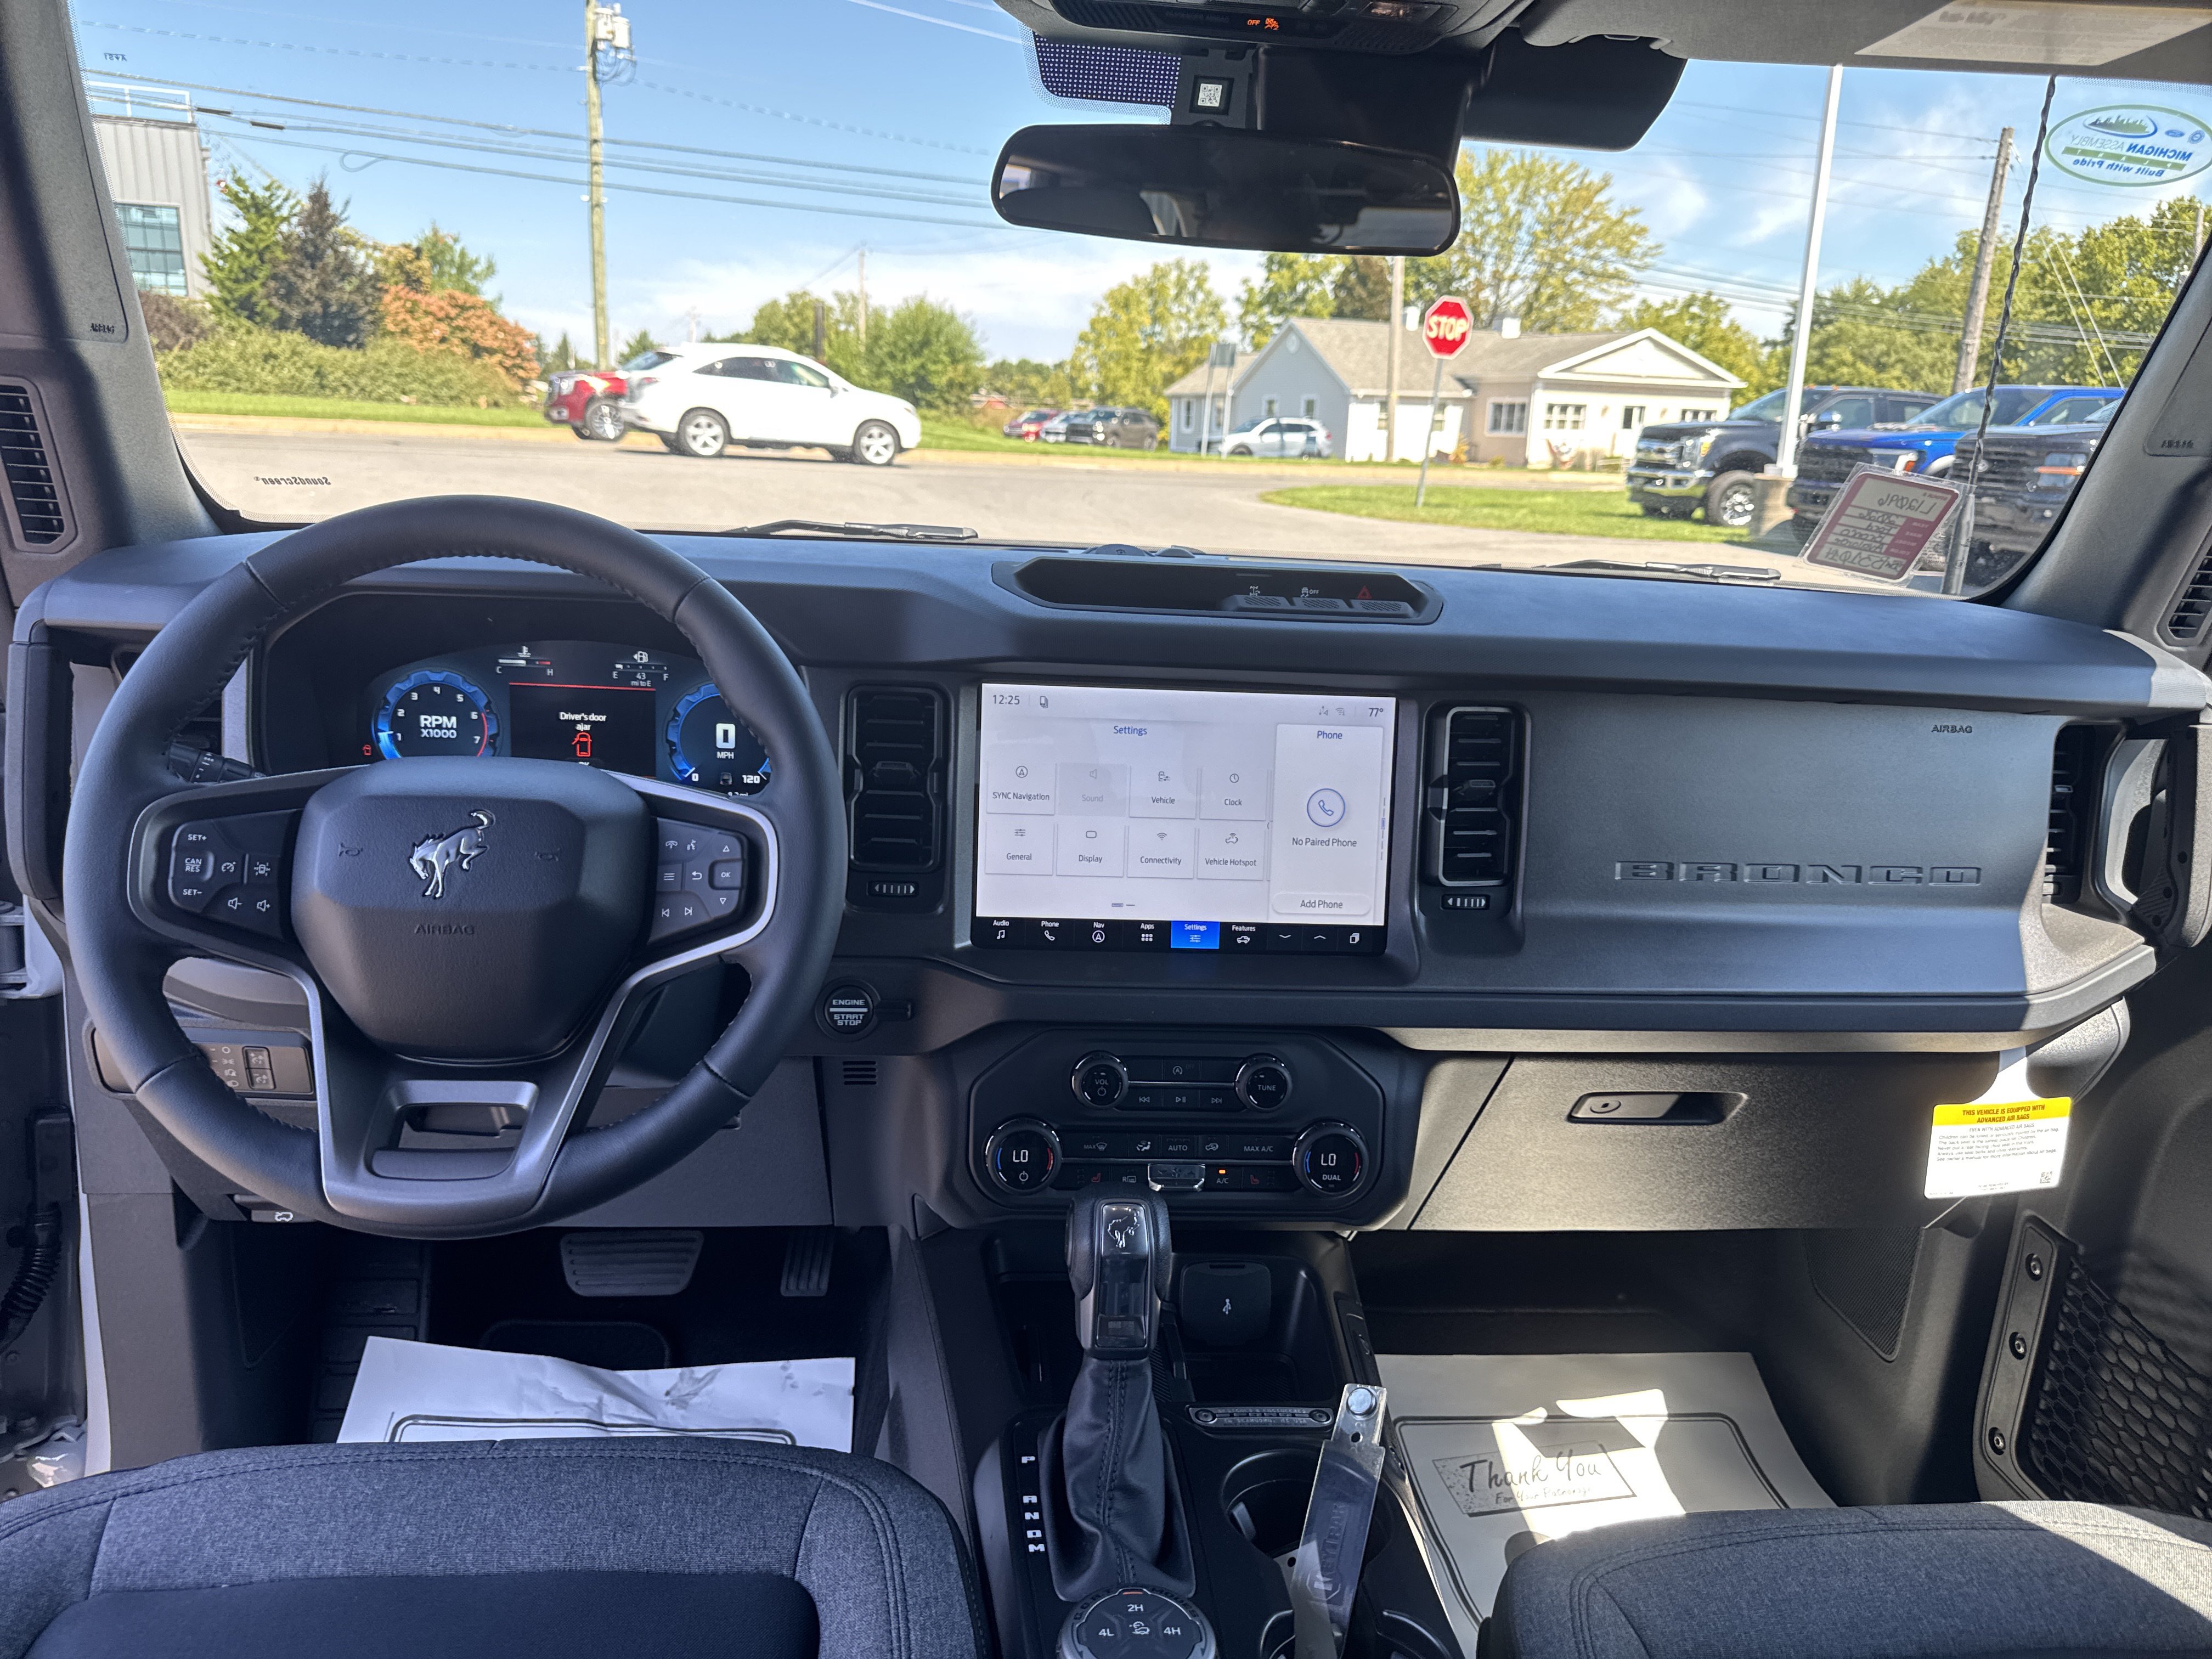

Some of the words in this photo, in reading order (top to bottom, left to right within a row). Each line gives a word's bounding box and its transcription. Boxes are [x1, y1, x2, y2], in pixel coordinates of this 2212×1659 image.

[1427, 315, 1468, 341] STOP
[433, 686, 441, 695] 4
[411, 692, 418, 701] 3
[456, 694, 464, 702] 5
[992, 695, 1020, 705] 12:25
[397, 709, 405, 717] 2
[471, 712, 478, 720] 6
[559, 712, 589, 721] Driver's
[589, 713, 607, 721] door
[1368, 708, 1384, 717] 77°
[420, 715, 457, 729] RPM
[575, 723, 591, 732] ajar
[1113, 725, 1147, 736] Settings
[1931, 724, 1972, 733] AIRBAG
[396, 733, 402, 741] 1
[420, 729, 457, 739] X1000
[715, 723, 736, 749] 0
[1317, 730, 1342, 740] Phone
[473, 736, 481, 744] 7
[691, 773, 699, 782] 0
[742, 775, 760, 783] 120
[992, 791, 1011, 800] SYNC
[1013, 792, 1049, 802] Navigation
[1082, 794, 1103, 802] Sound
[1152, 796, 1175, 804] Vehicle
[1224, 798, 1242, 806] Clock
[1292, 838, 1304, 846] No
[1305, 838, 1330, 847] Paired
[1331, 838, 1357, 847] Phone
[1006, 853, 1032, 861] General
[1078, 854, 1103, 864] Display
[1140, 856, 1182, 866] Connectivity
[1205, 857, 1228, 866] Vehicle
[1229, 858, 1256, 867] Hotspot
[1614, 860, 1982, 887] BRONCO
[1300, 900, 1316, 908] Add
[1318, 900, 1343, 909] Phone
[414, 924, 475, 935] AIRBAG
[1140, 922, 1155, 931] Apps
[1184, 923, 1207, 932] Settings
[1012, 1149, 1029, 1163] LO
[1321, 1153, 1336, 1166] LO
[1460, 1454, 1549, 1493] Thank
[1556, 1448, 1601, 1481] You
[1496, 1492, 1514, 1504] For
[1026, 1530, 1042, 1538] D
[1028, 1544, 1045, 1552] M
[1152, 1587, 1199, 1618] MODES
[1098, 1628, 1114, 1637] 4L
[1163, 1627, 1181, 1635] 4H
